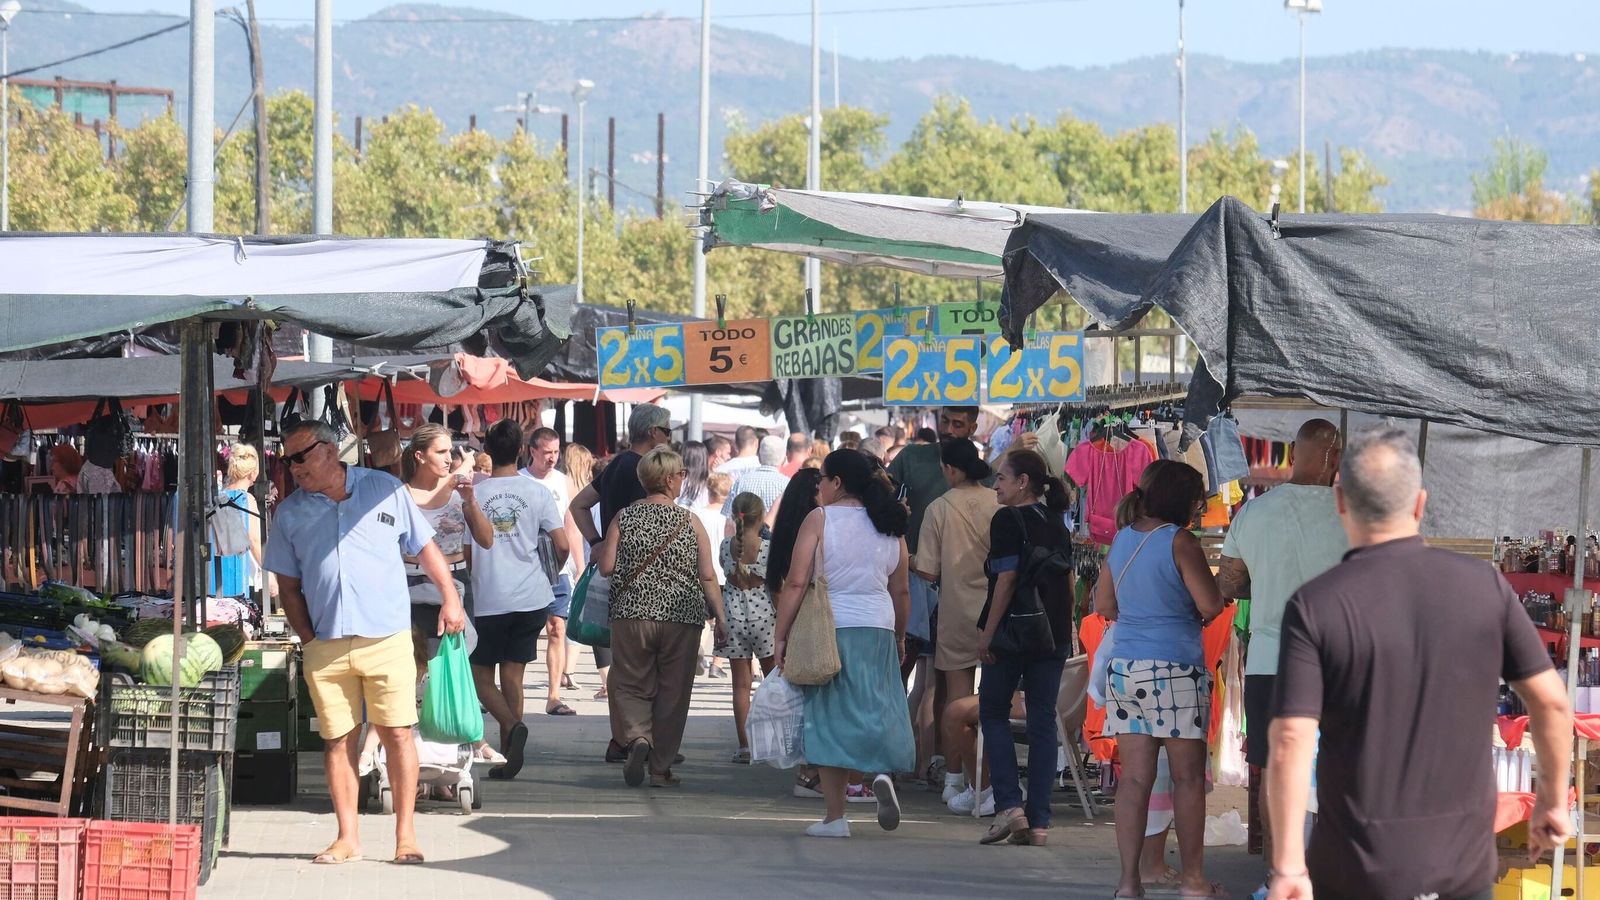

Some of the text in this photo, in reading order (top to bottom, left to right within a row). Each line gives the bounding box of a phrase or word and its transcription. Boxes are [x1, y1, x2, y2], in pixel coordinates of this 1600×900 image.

[699, 327, 756, 342] TODO
[774, 318, 851, 349] GRANDES
[709, 346, 748, 373] 5 €
[775, 338, 855, 377] REBAJAS
[482, 493, 528, 512] SUMMER SUNSHINE
